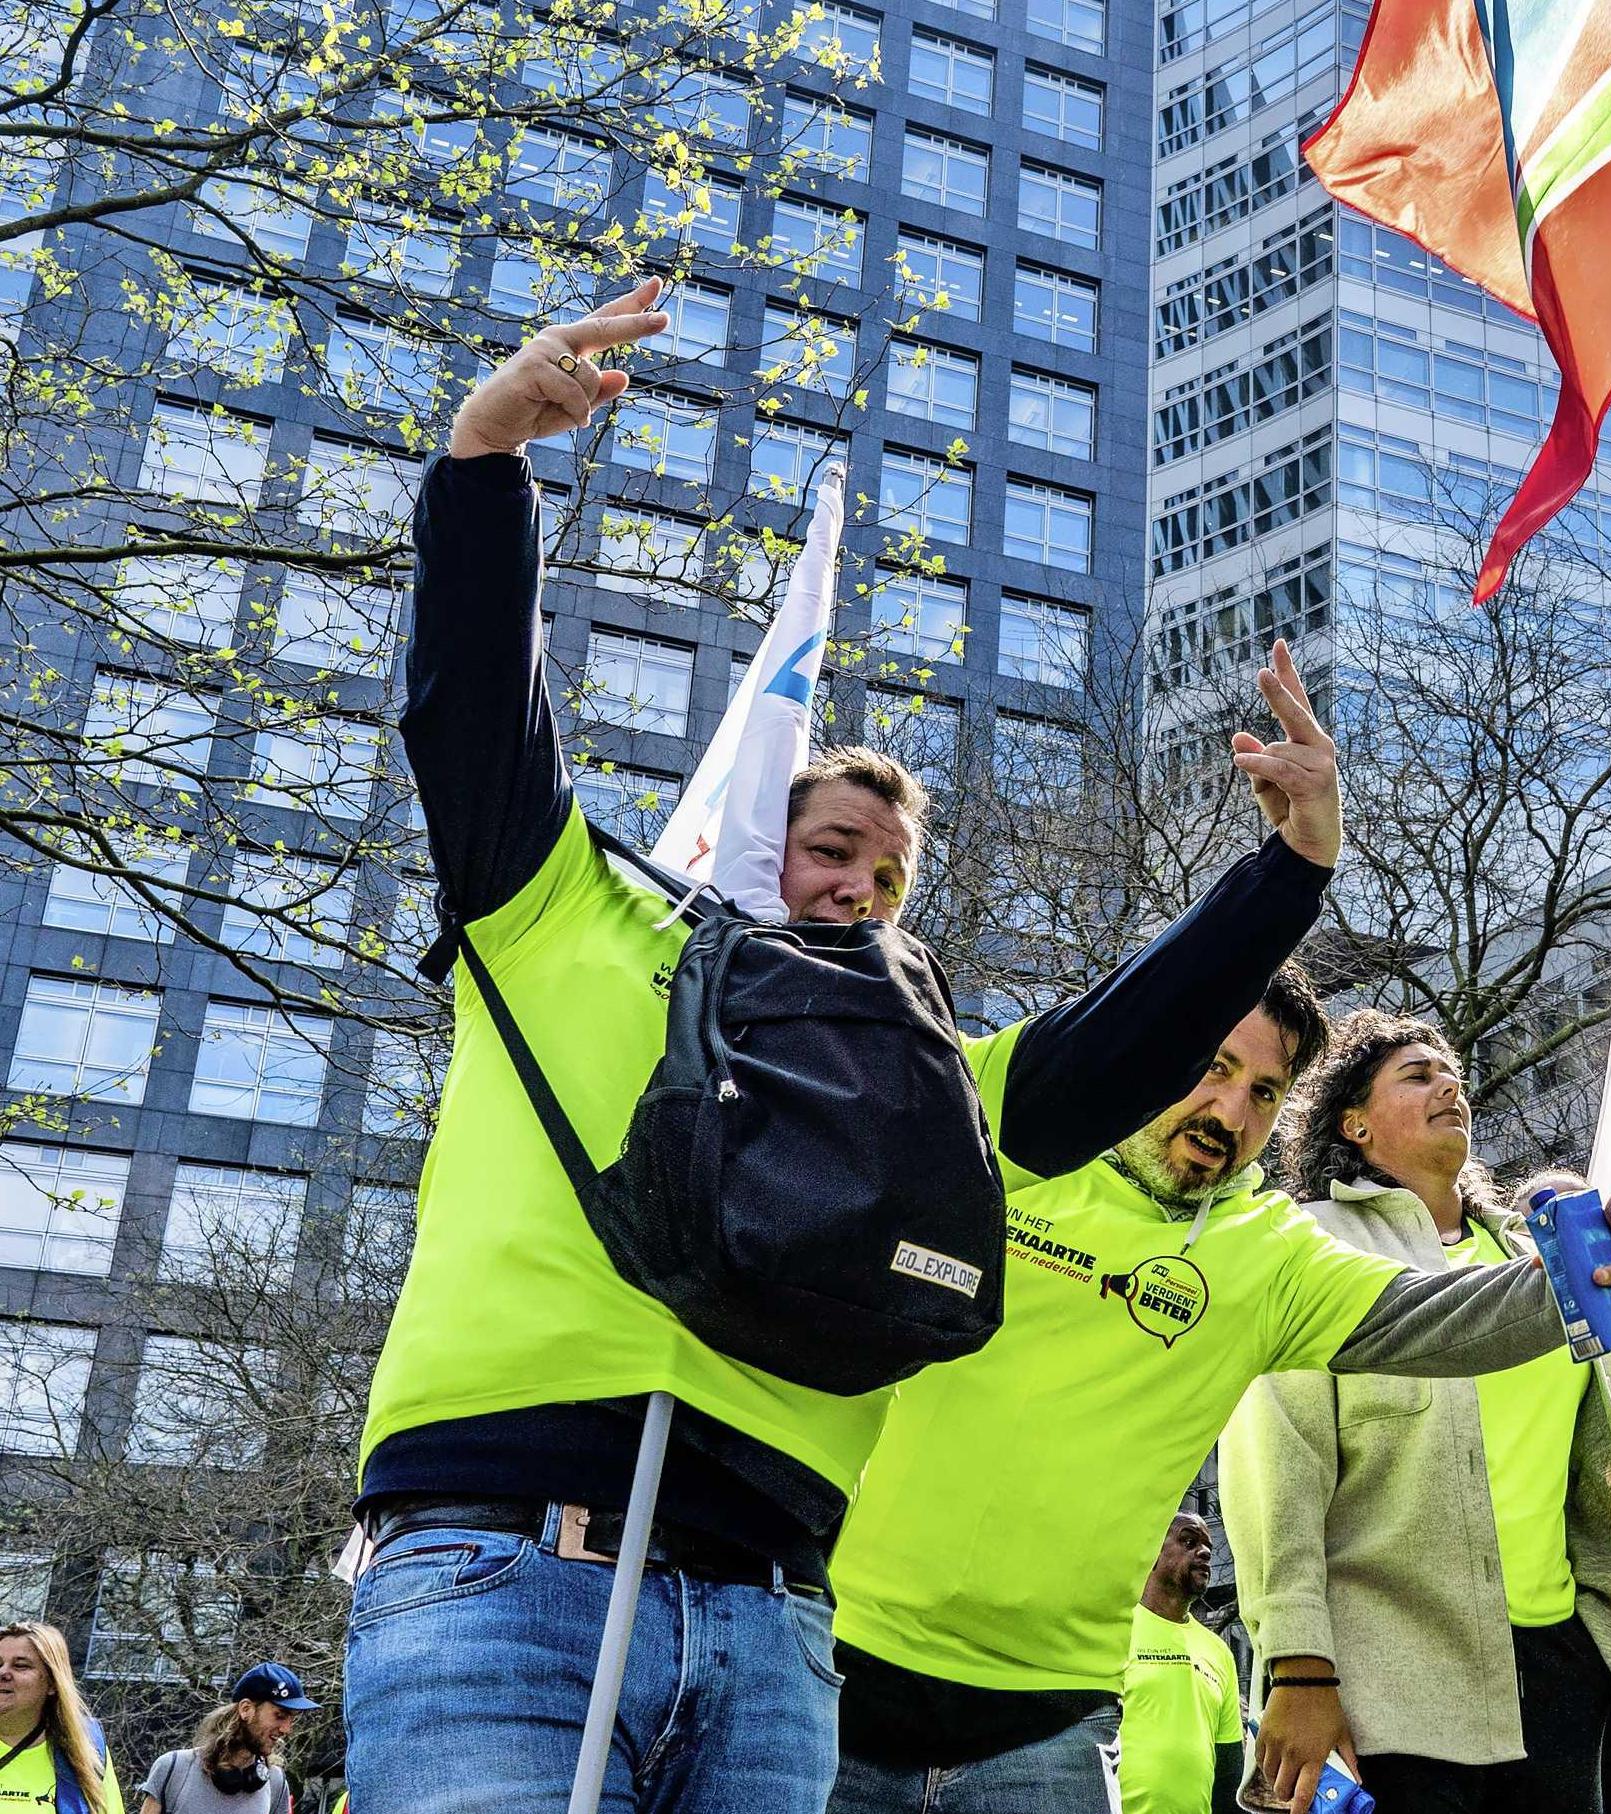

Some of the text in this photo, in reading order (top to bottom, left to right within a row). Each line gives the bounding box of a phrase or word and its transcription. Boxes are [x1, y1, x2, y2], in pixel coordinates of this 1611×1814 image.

[1024, 1214, 1054, 1233] HET
[1006, 1225, 1097, 1270] EKAARTJE
[896, 1248, 979, 1293] GO_EXPLORE
[1030, 1256, 1093, 1284] nederland
[1139, 1291, 1192, 1325] BETER
[1145, 1281, 1198, 1310] VERDIENT
